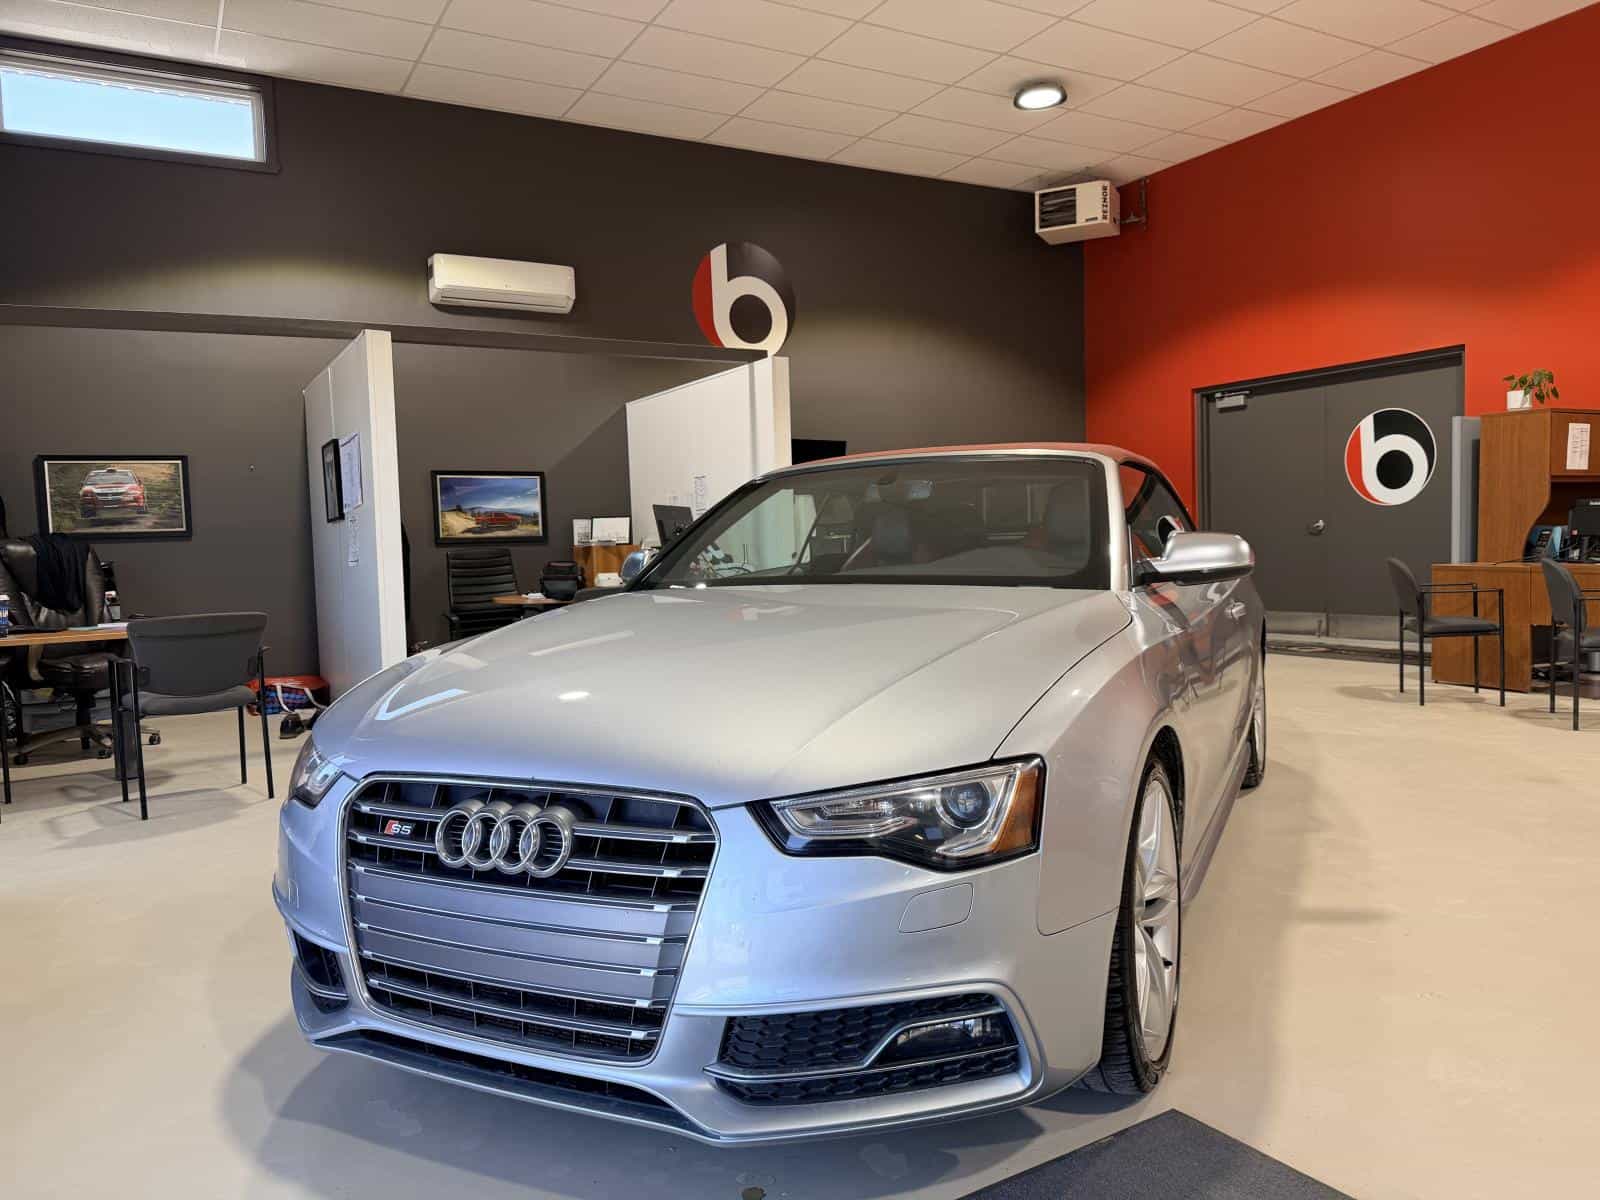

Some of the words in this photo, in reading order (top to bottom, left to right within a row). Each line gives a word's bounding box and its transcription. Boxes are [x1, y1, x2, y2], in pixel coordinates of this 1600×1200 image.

[710, 242, 788, 356] b
[1359, 413, 1429, 506] b
[391, 823, 413, 836] S5
